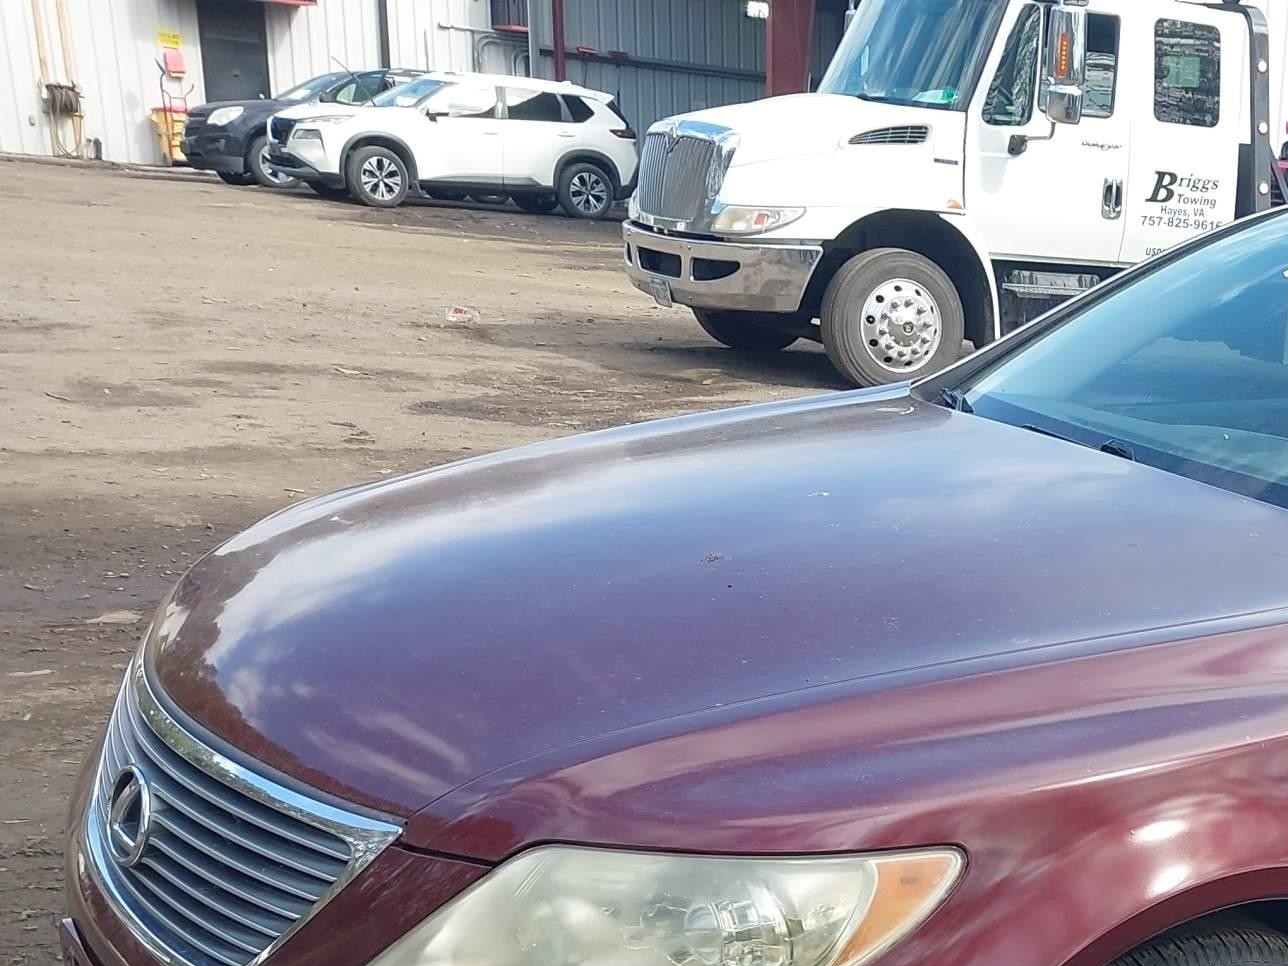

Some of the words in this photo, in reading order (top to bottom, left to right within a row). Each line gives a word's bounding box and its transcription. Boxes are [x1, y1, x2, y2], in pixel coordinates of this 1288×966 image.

[1144, 170, 1220, 203] Briggs
[1177, 193, 1217, 209] Towing
[1160, 205, 1191, 219] Hayes,
[1193, 207, 1205, 218] VA
